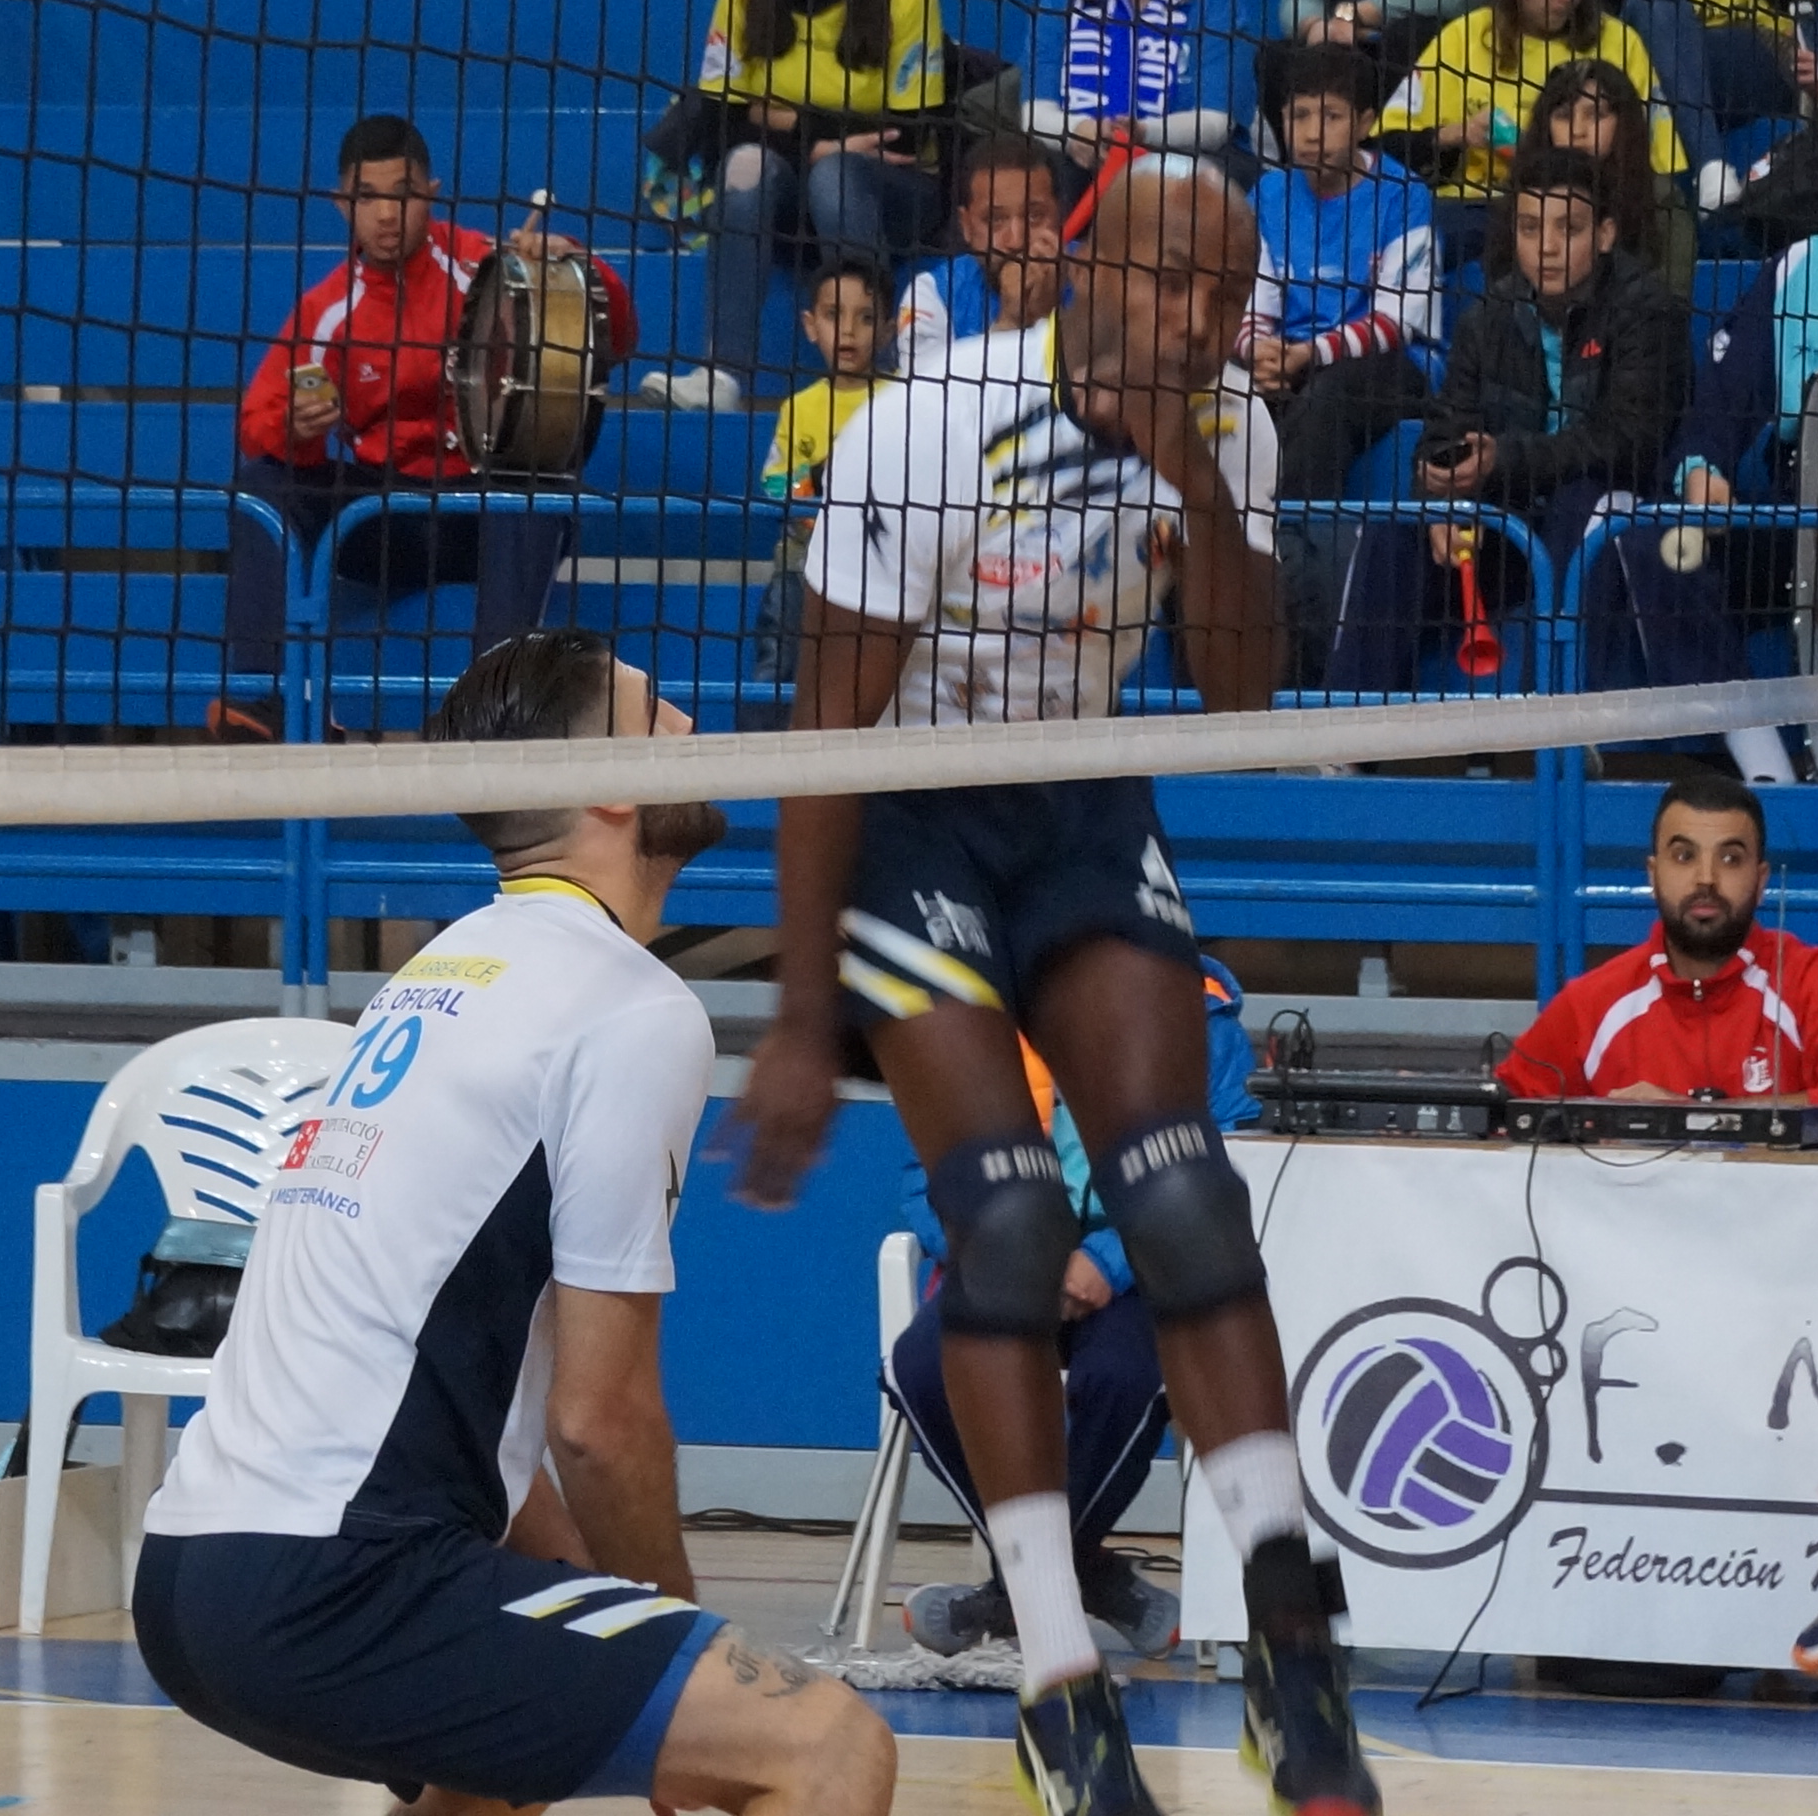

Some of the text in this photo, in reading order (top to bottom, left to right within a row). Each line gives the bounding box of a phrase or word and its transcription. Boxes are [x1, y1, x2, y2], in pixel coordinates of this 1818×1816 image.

[390, 987, 465, 1018] OFICIAL
[327, 1015, 423, 1110] 19
[1548, 1526, 1785, 1590] Federación
